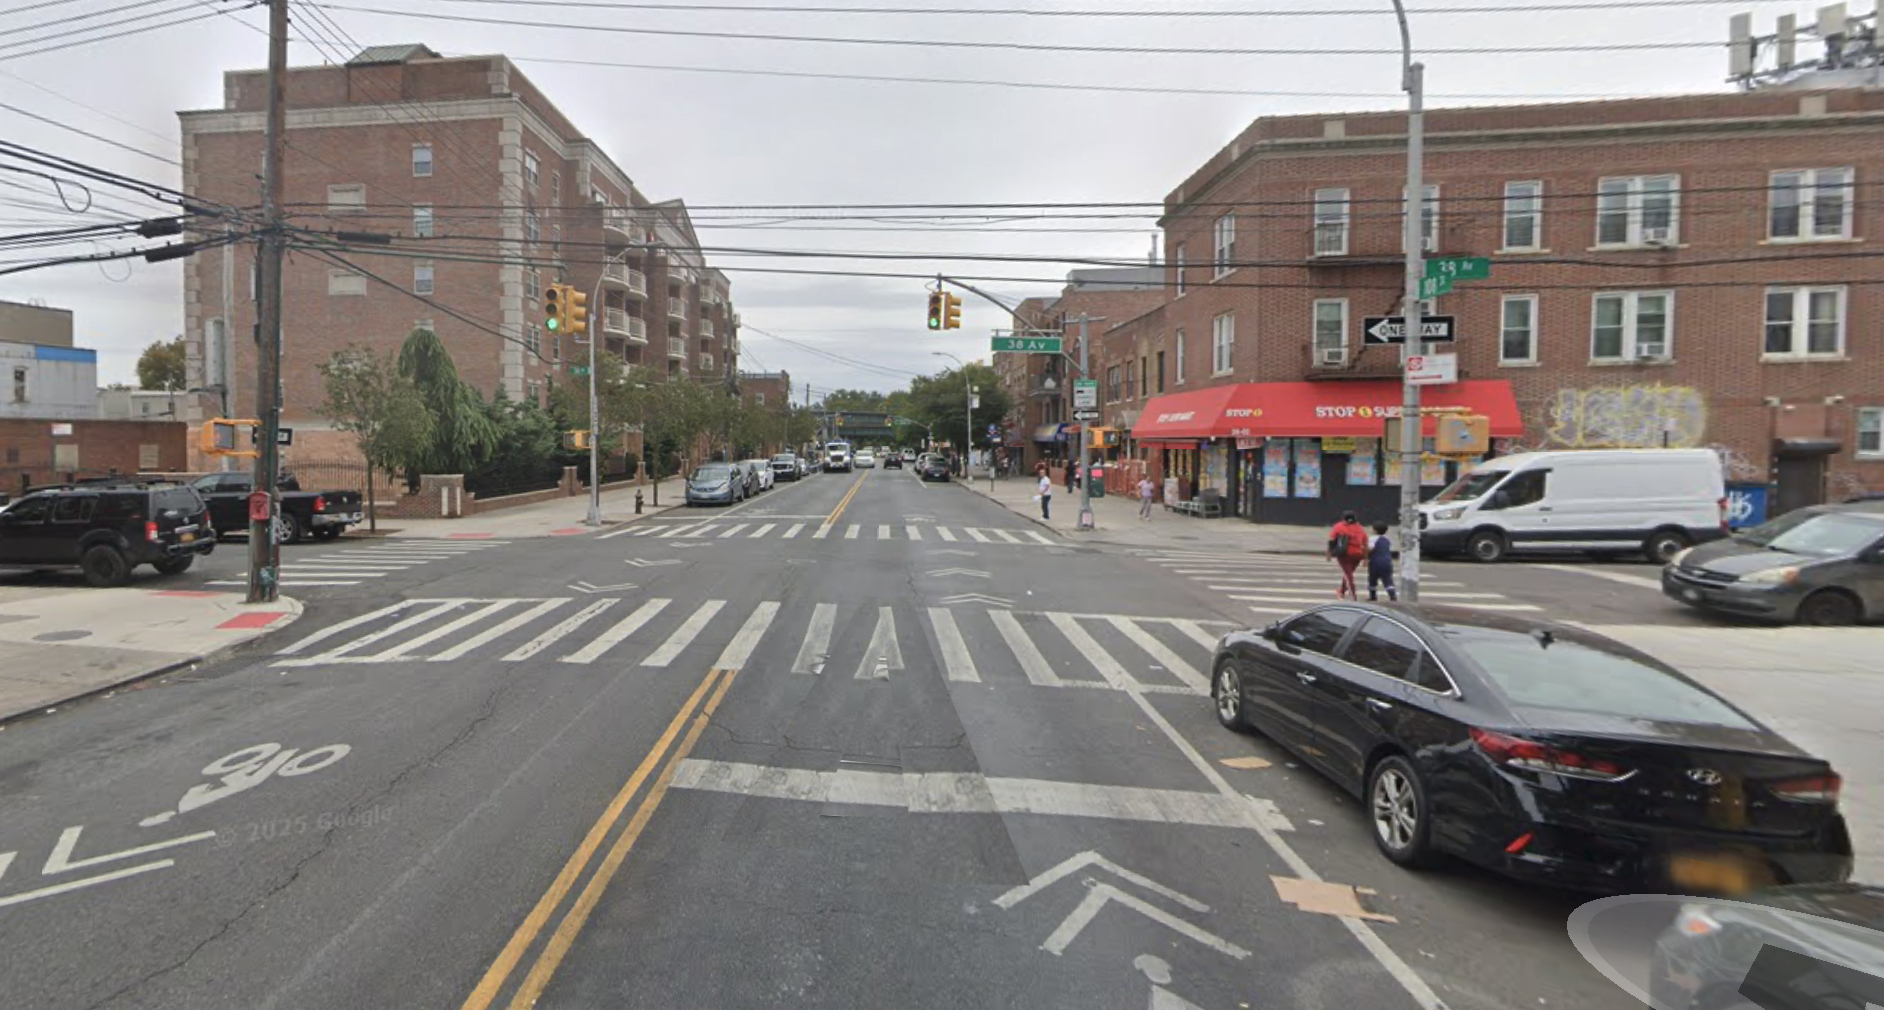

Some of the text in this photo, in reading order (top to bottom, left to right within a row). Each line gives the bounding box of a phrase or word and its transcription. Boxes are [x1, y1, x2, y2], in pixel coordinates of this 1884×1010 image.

[1379, 325, 1405, 336] ONE
[1007, 340, 1046, 350] 38 Av
[1226, 409, 1252, 417] STOP
[1316, 406, 1356, 418] STOP
